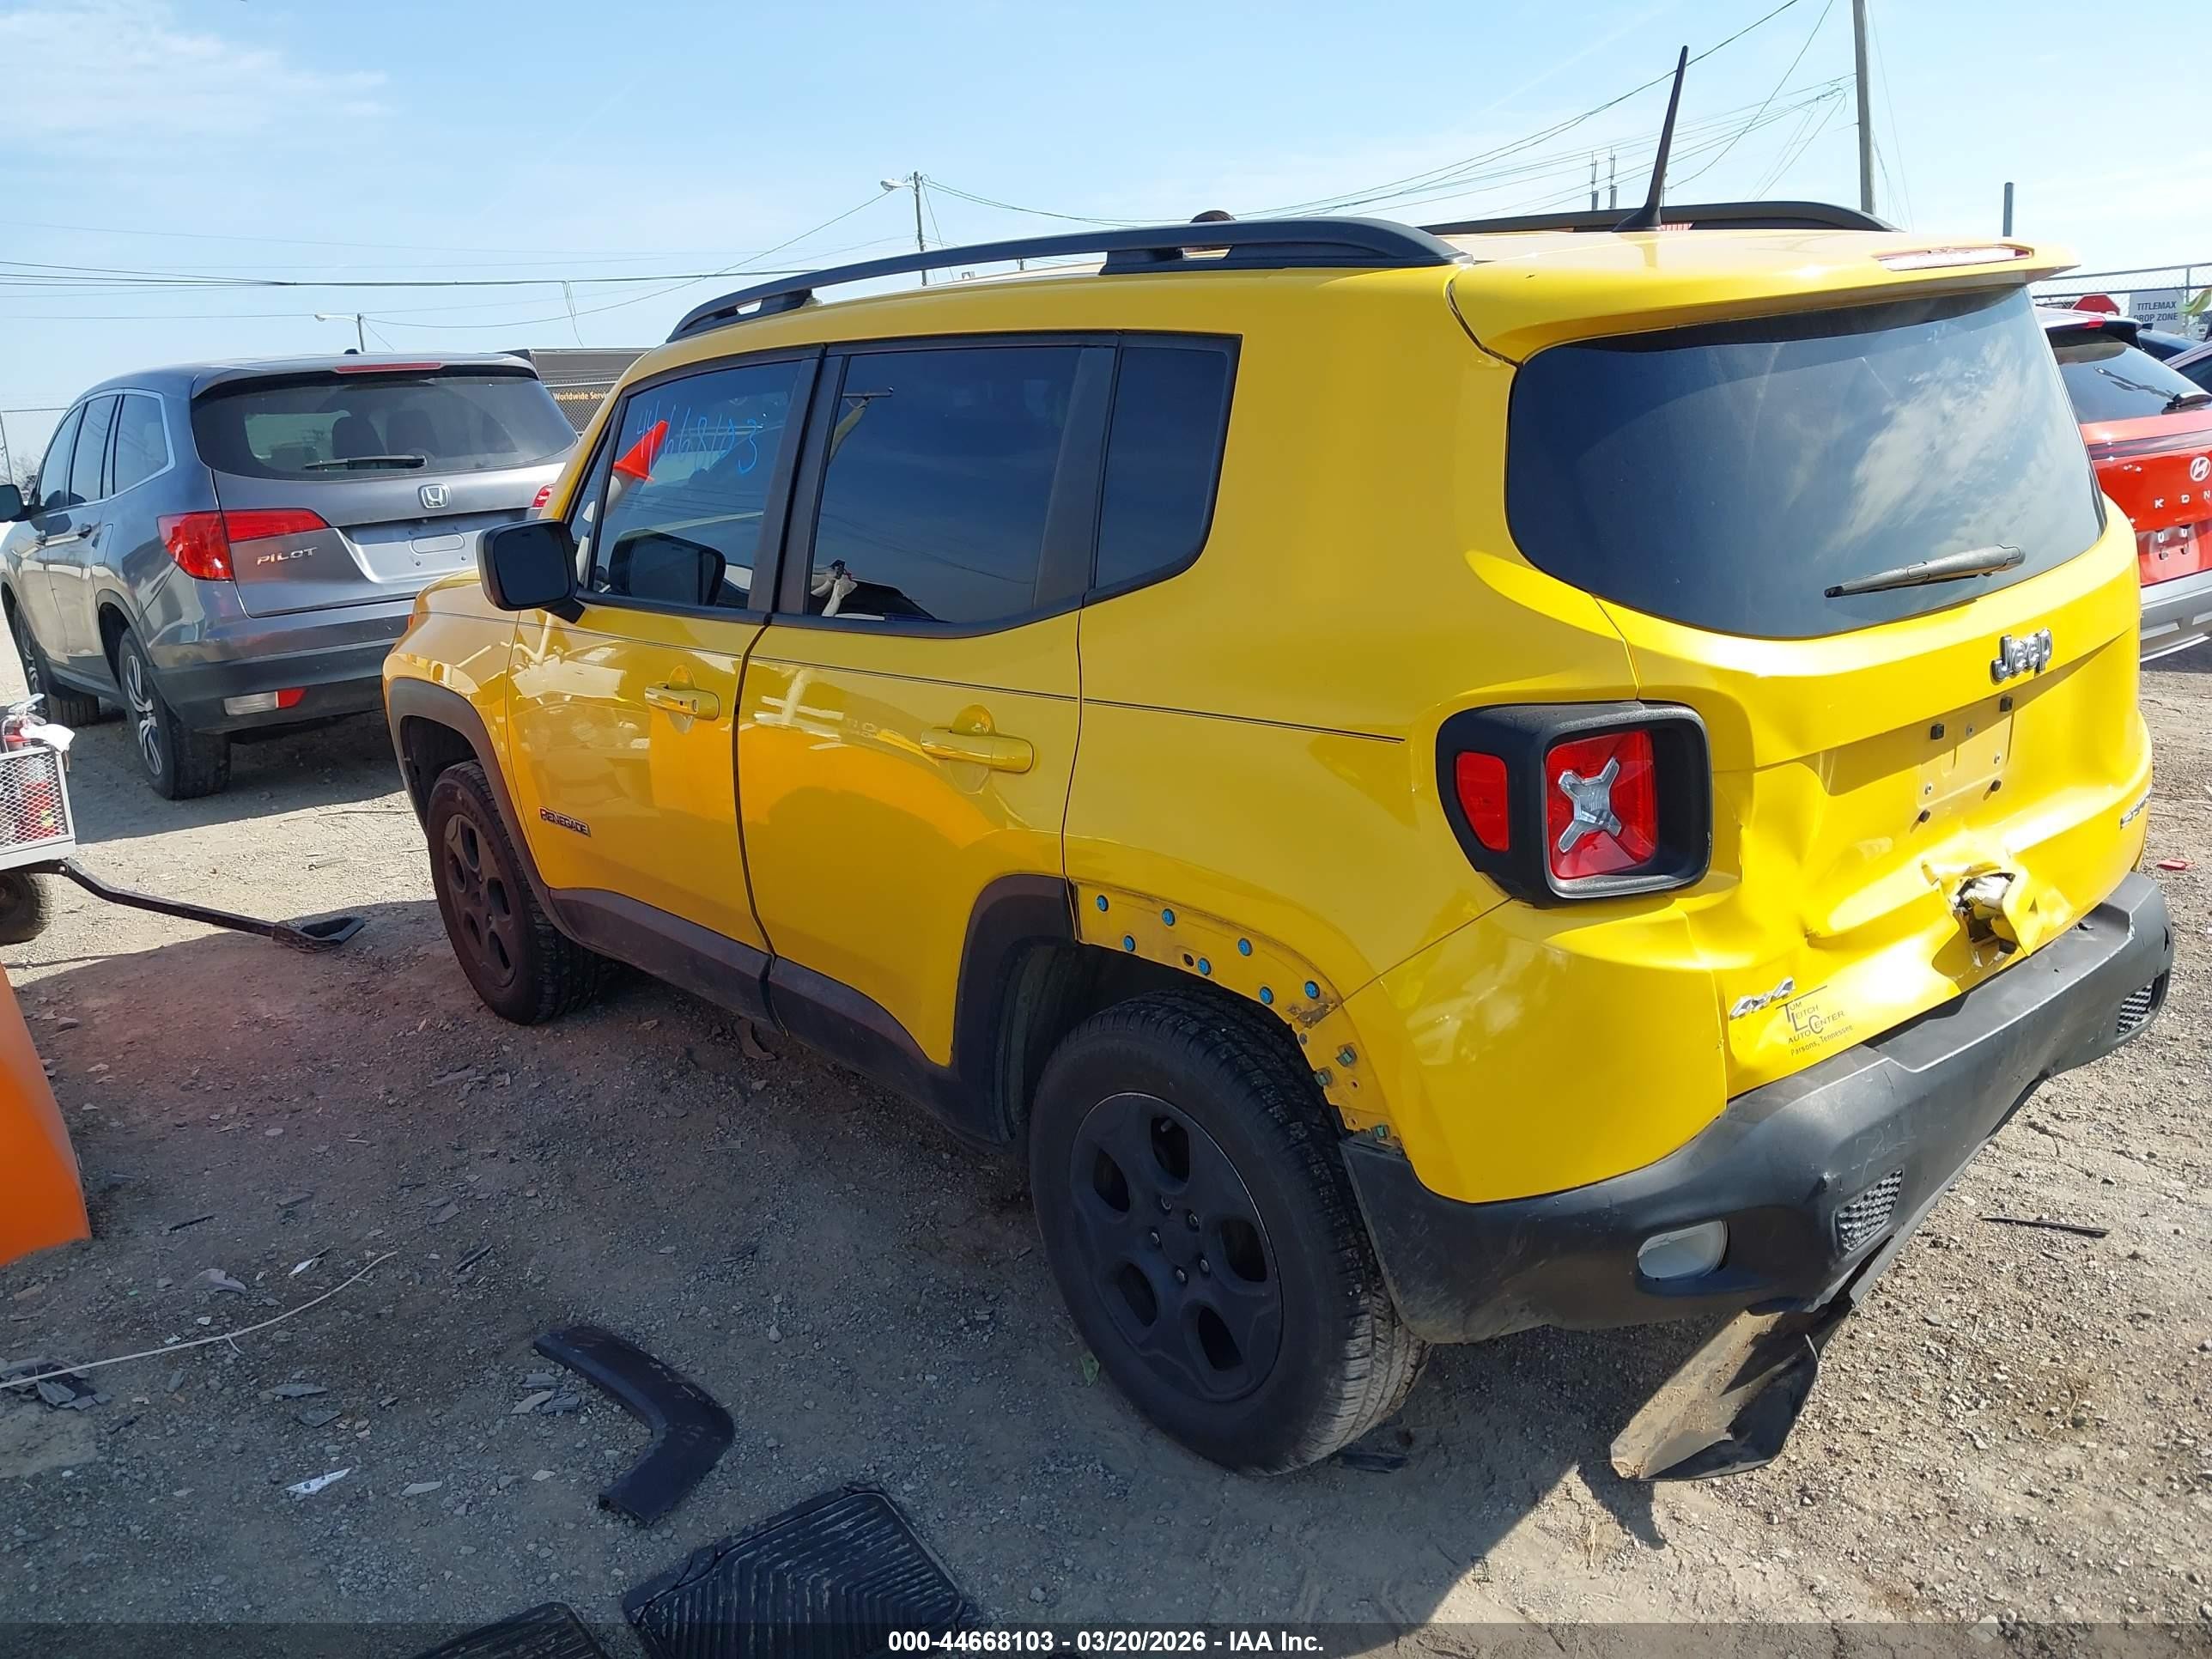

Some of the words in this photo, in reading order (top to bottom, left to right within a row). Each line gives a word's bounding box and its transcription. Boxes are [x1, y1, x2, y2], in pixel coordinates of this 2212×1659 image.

[2137, 301, 2177, 310] TITLEMAX
[2156, 313, 2178, 321] ZONE
[553, 391, 588, 401] Worldwide
[257, 546, 319, 566] PILOT
[1990, 629, 2052, 683] Jeep
[538, 806, 591, 837] RENEGADE
[1788, 1030, 1813, 1045] AUTO
[1808, 1010, 1845, 1035] CENTER
[1791, 1004, 1820, 1032] LEITCH
[1791, 1041, 1820, 1056] Parsons,
[1820, 1024, 1854, 1044] Tennessee
